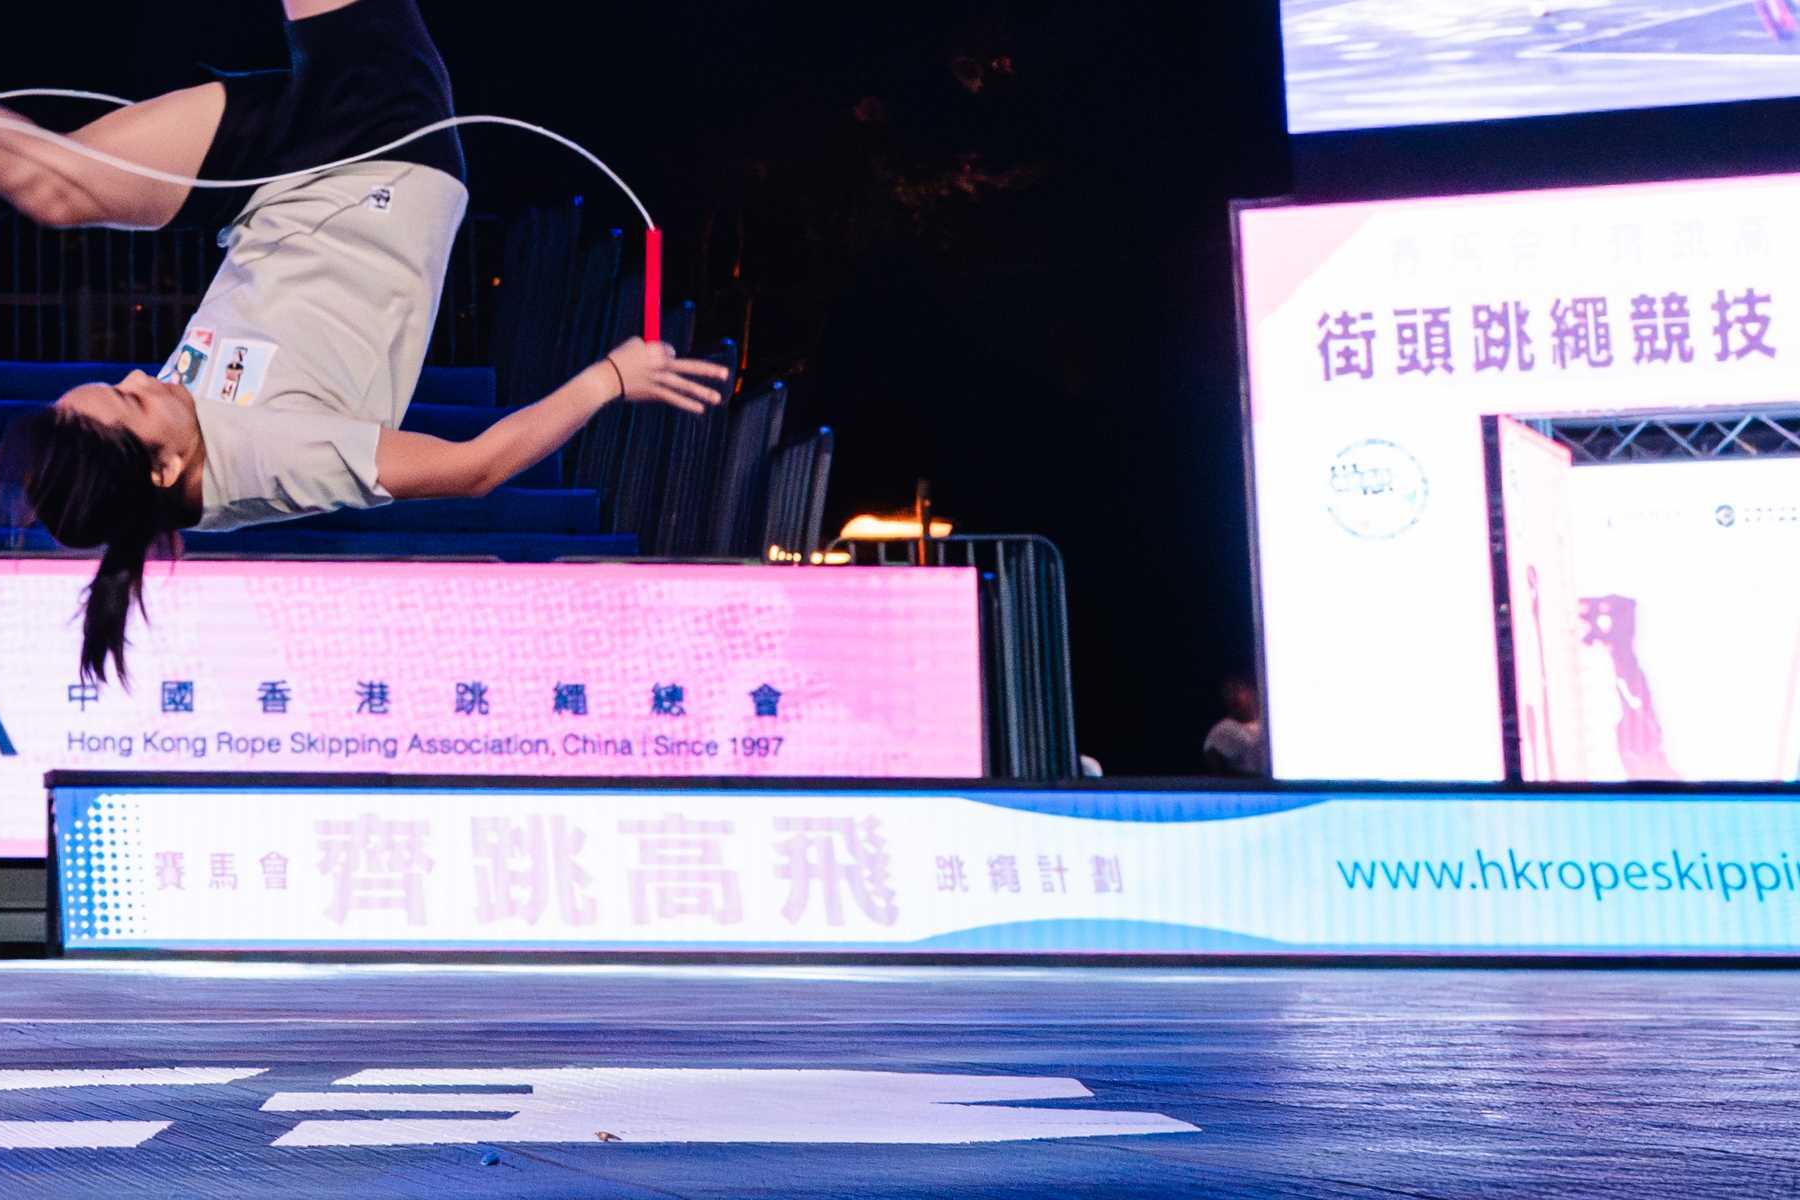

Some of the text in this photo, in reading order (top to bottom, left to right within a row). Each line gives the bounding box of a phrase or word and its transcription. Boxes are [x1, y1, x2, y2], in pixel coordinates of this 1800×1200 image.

[1317, 288, 1777, 381] 街頭跳繩競技
[68, 680, 783, 717] 中國香港跳繩總會
[67, 731, 132, 755] Hong
[143, 732, 207, 756] Kong
[217, 732, 281, 755] Rope
[290, 732, 398, 757] Skipping
[562, 734, 634, 757] China
[653, 734, 719, 757] Since
[730, 735, 784, 757] 1997
[1336, 849, 1800, 902] www.hkropeskippi
